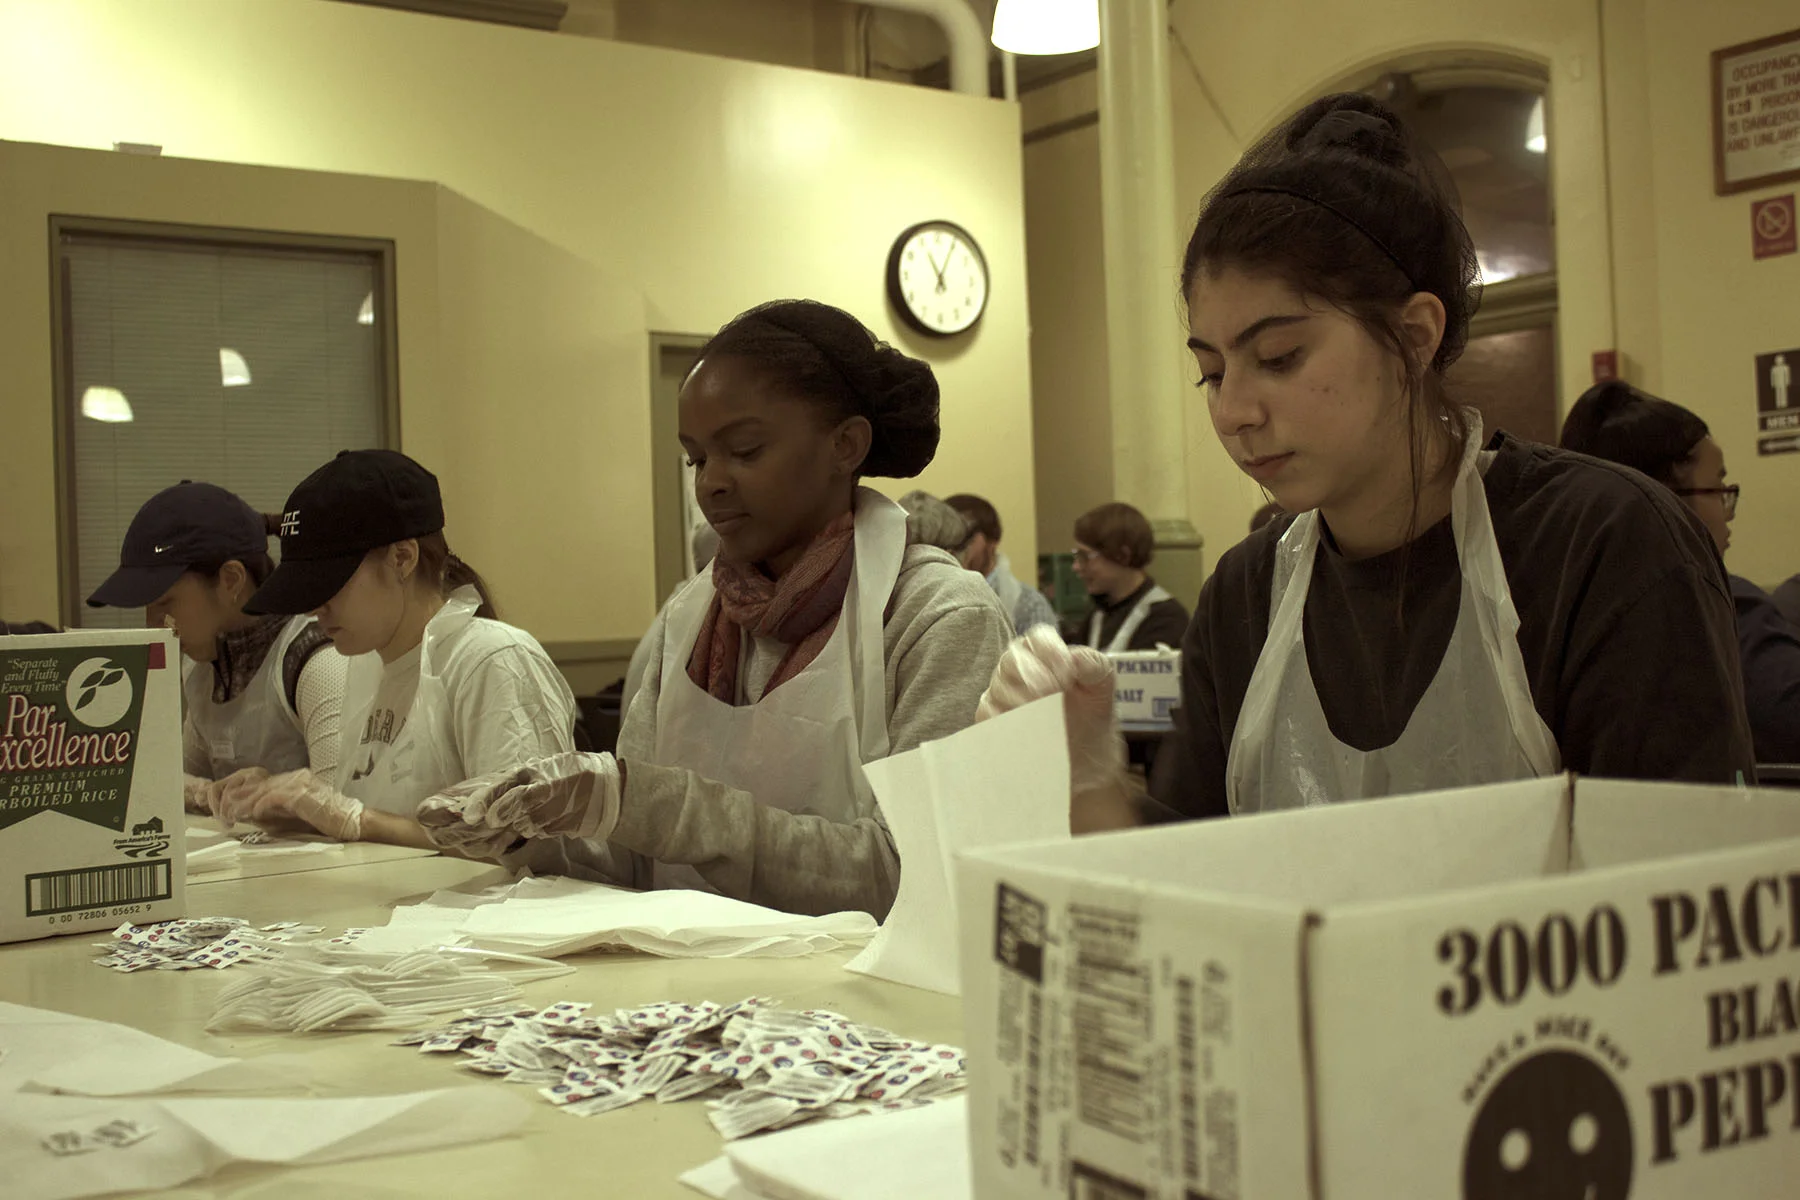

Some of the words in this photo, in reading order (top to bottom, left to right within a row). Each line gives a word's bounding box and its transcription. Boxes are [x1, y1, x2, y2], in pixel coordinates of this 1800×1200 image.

[1746, 77, 1778, 94] MORE
[1726, 137, 1750, 151] AND
[4, 669, 25, 682] and
[28, 669, 60, 682] Fluffy
[1, 681, 32, 694] Every
[5, 694, 56, 738] Par
[61, 768, 125, 780] ENRICHED
[9, 780, 87, 797] PREMIUM
[80, 788, 118, 803] RICE
[49, 916, 55, 924] 0
[60, 914, 73, 923] 00
[78, 910, 107, 920] 72806
[113, 906, 140, 916] 05652
[145, 904, 152, 912] 9
[1435, 903, 1628, 1017] 3000
[1706, 976, 1800, 1051] BLA
